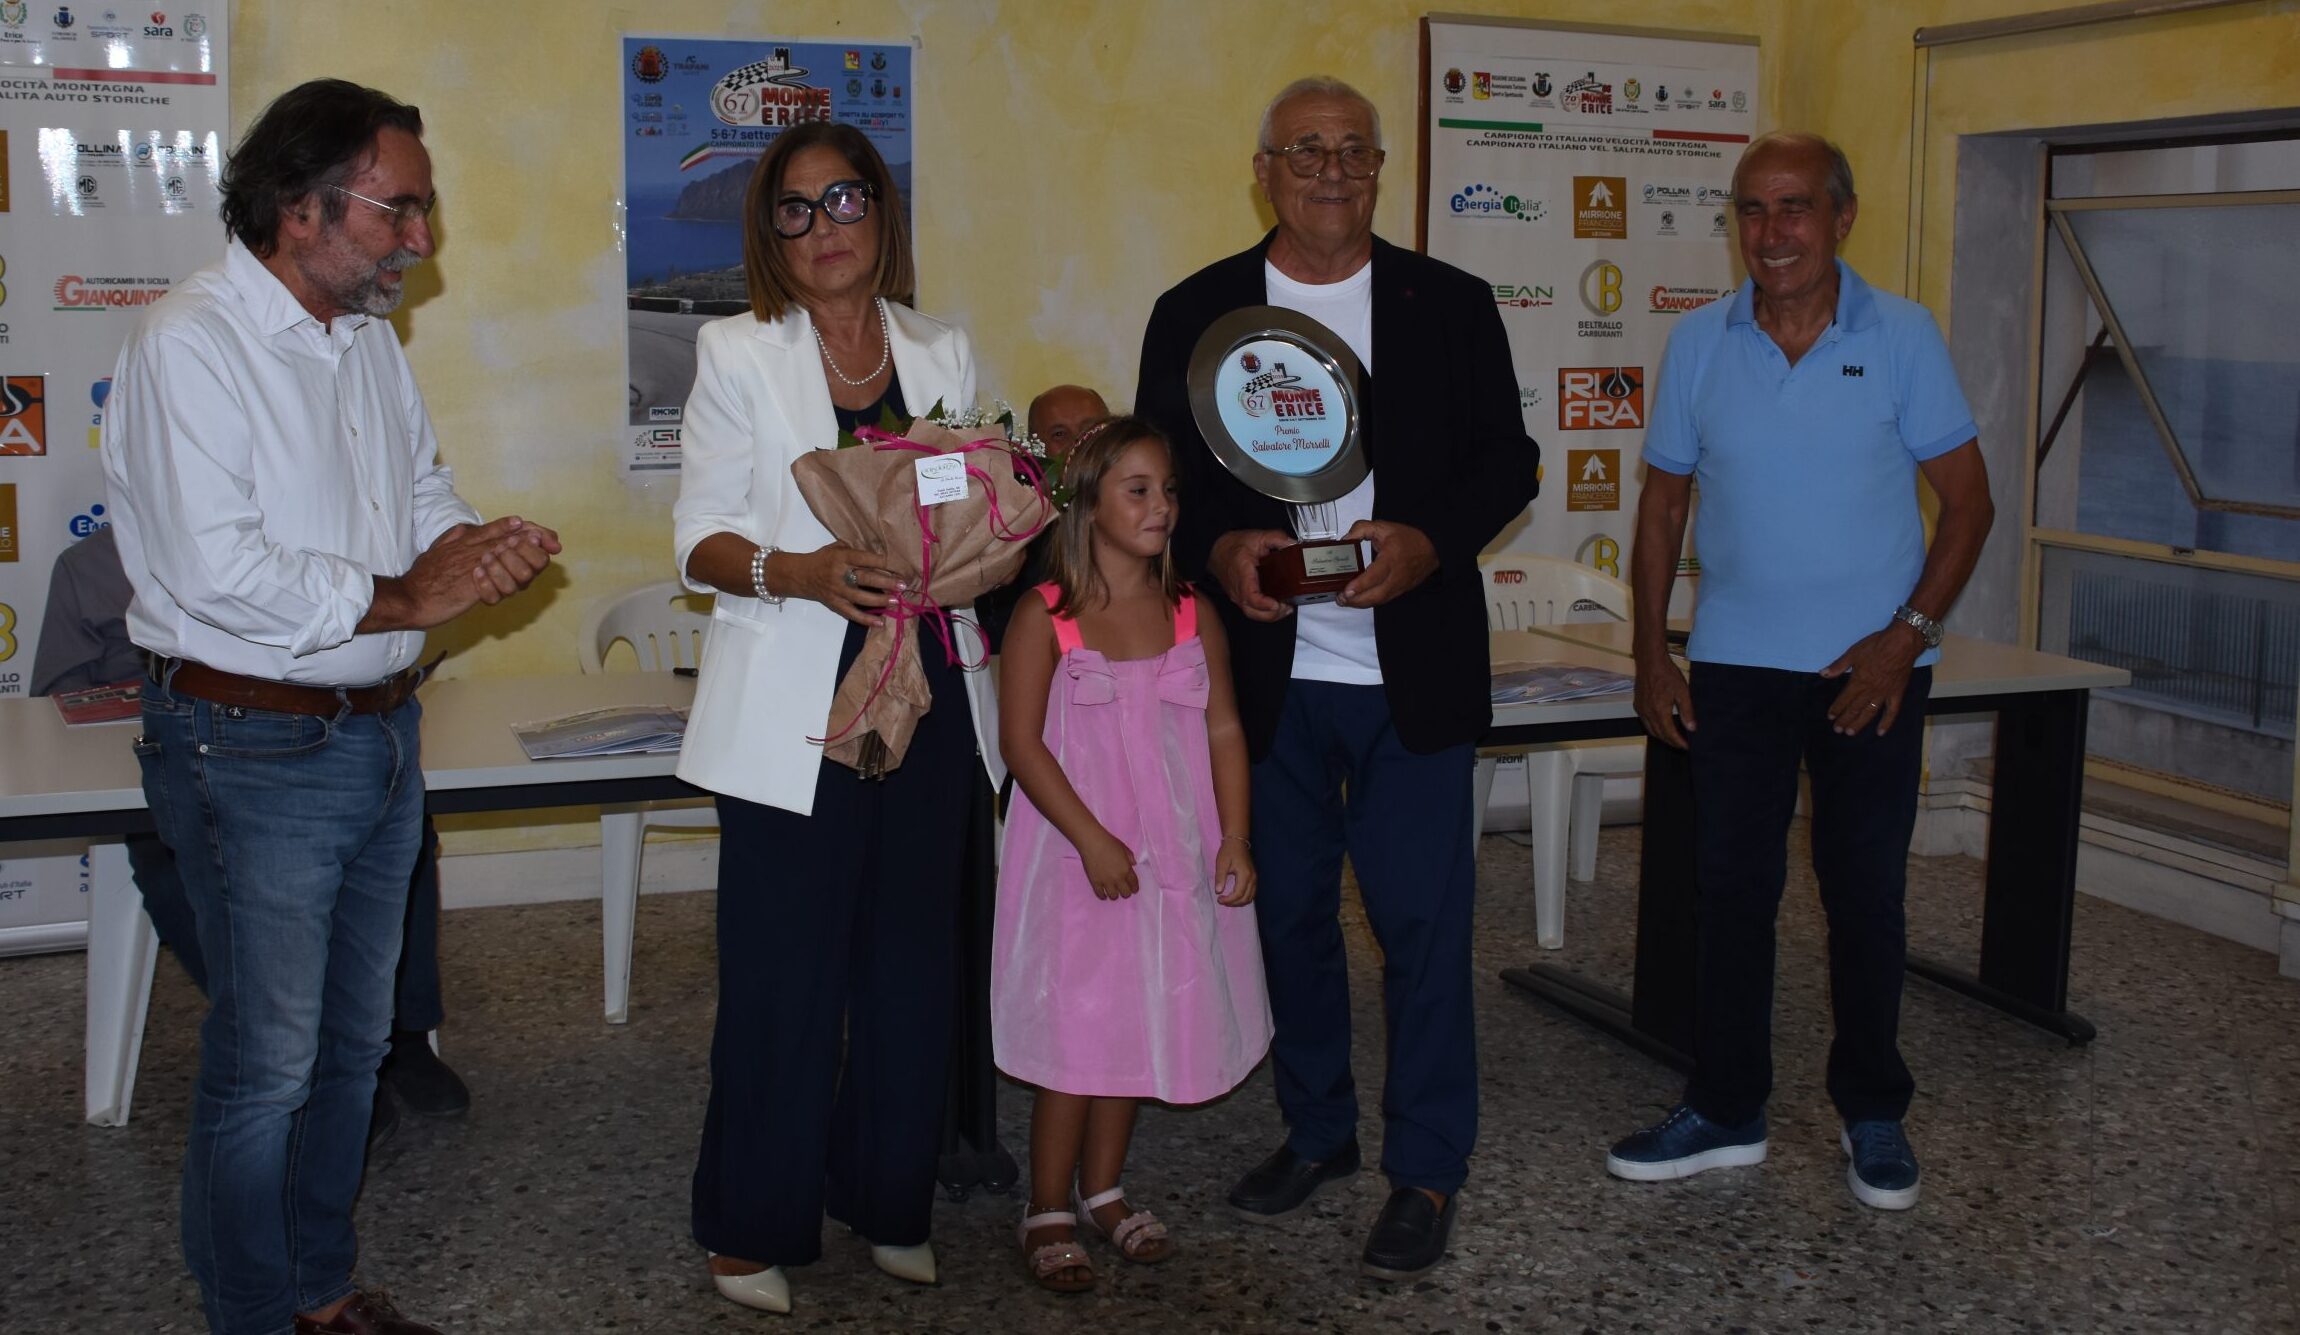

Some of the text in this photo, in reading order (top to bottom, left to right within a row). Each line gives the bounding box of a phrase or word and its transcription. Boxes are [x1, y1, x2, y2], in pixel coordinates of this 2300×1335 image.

[4, 31, 24, 40] Erice
[143, 26, 173, 37] sara
[0, 79, 145, 94] OCITÀ MONTAGNA
[44, 93, 88, 102] AUTO
[93, 95, 171, 106] STORICHE
[723, 93, 749, 111] 67
[761, 88, 831, 106] MONTE
[1581, 103, 1613, 114] ERICE
[1708, 100, 1726, 108] sara
[1484, 132, 1708, 149] CAMPIONATO ITALIANO VELOCITÀ MONTAGNA
[76, 144, 122, 153] OLLINA
[1466, 140, 1536, 149] CAMPIONATO
[1538, 142, 1586, 151] ITALIANO
[1613, 146, 1646, 154] SALITA
[1648, 148, 1673, 156] AUTO
[1676, 150, 1722, 158] STORICHE
[1656, 187, 1690, 195] POLLINA
[1709, 189, 1732, 197] POLL
[1455, 198, 1540, 212] Energia Italia
[1579, 209, 1623, 220] MIRRIONE
[85, 277, 136, 285] AUTORICAMBI
[1490, 285, 1553, 299] SAN
[1577, 321, 1623, 330] BELTRALLO
[1577, 330, 1623, 339] CARBURANTI
[1842, 365, 1864, 377] HH
[1271, 388, 1322, 403] MONTE
[1246, 395, 1266, 411] 67
[1275, 402, 1326, 417] ERICE
[1565, 399, 1641, 428] FRA
[1251, 439, 1292, 453] Salvatore
[1573, 483, 1617, 492] MIRRIONE
